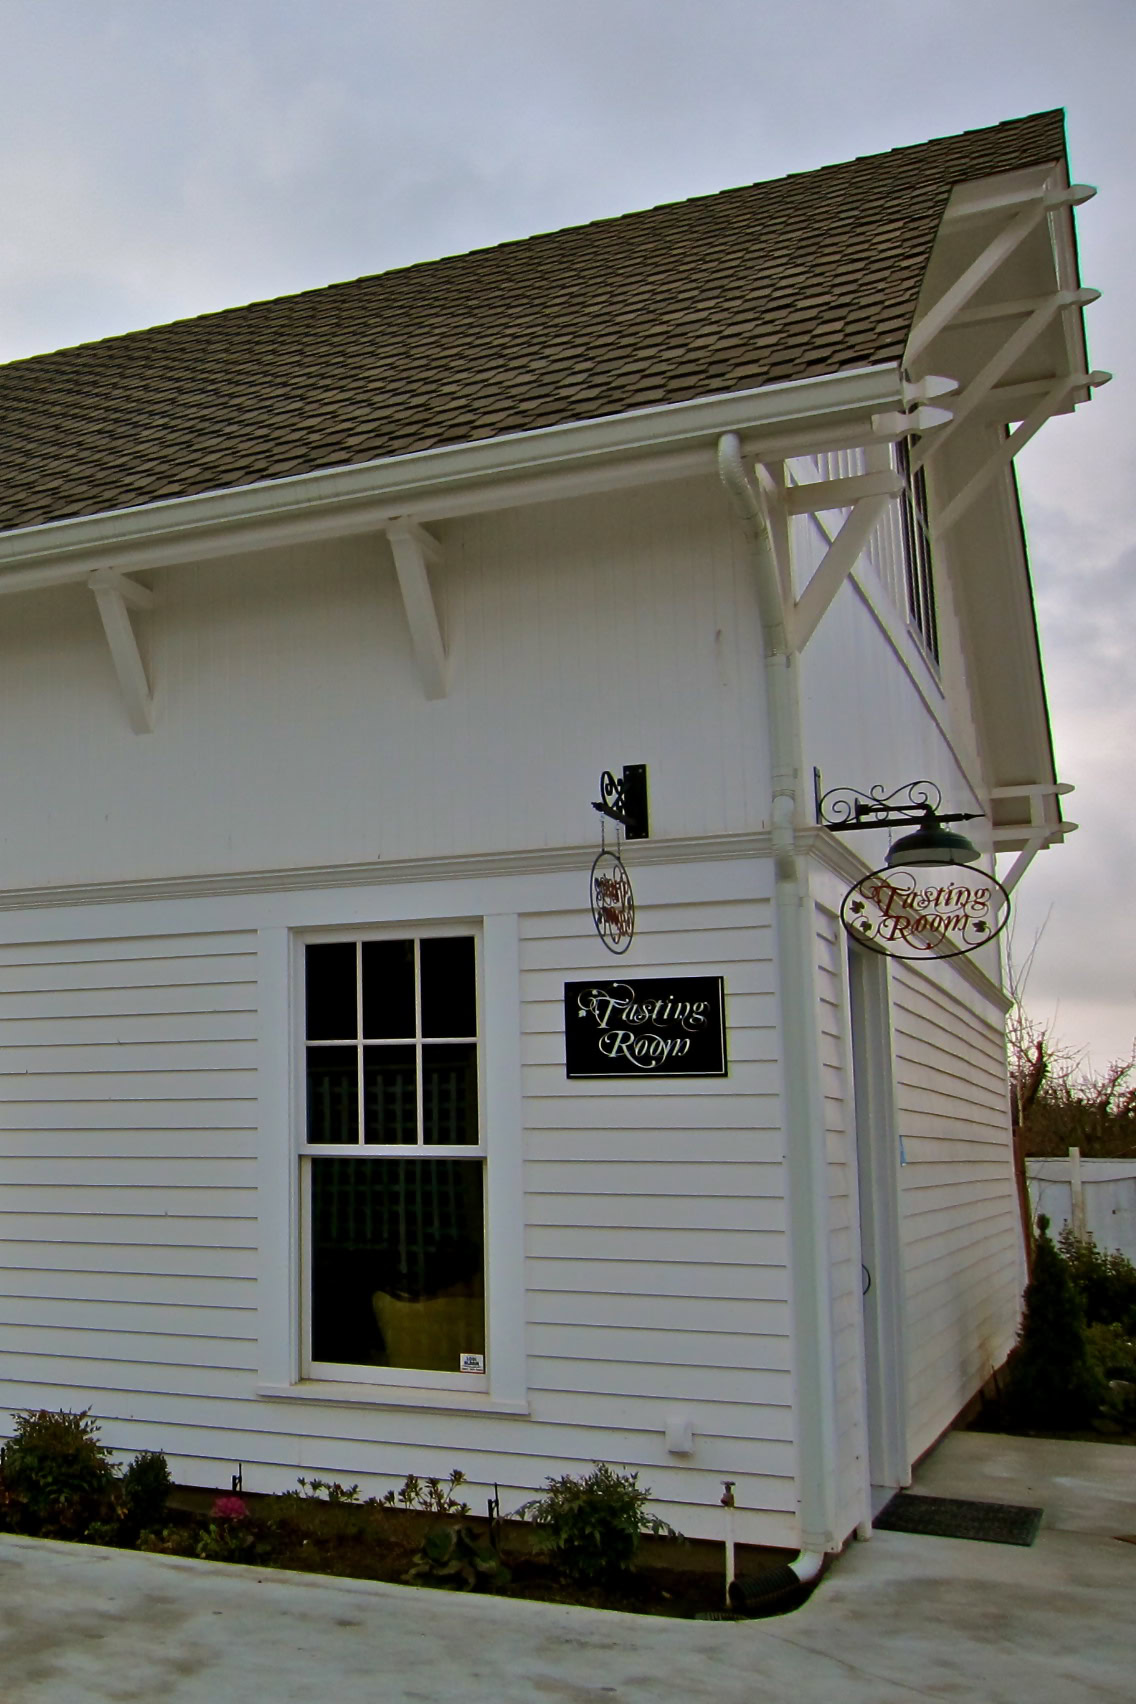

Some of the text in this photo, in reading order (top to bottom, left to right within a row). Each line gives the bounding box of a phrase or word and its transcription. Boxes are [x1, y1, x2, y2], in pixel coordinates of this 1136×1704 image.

[860, 872, 991, 918] Tasting
[878, 914, 969, 950] Room
[578, 984, 710, 1031] Tasting
[599, 1031, 690, 1068] Room
